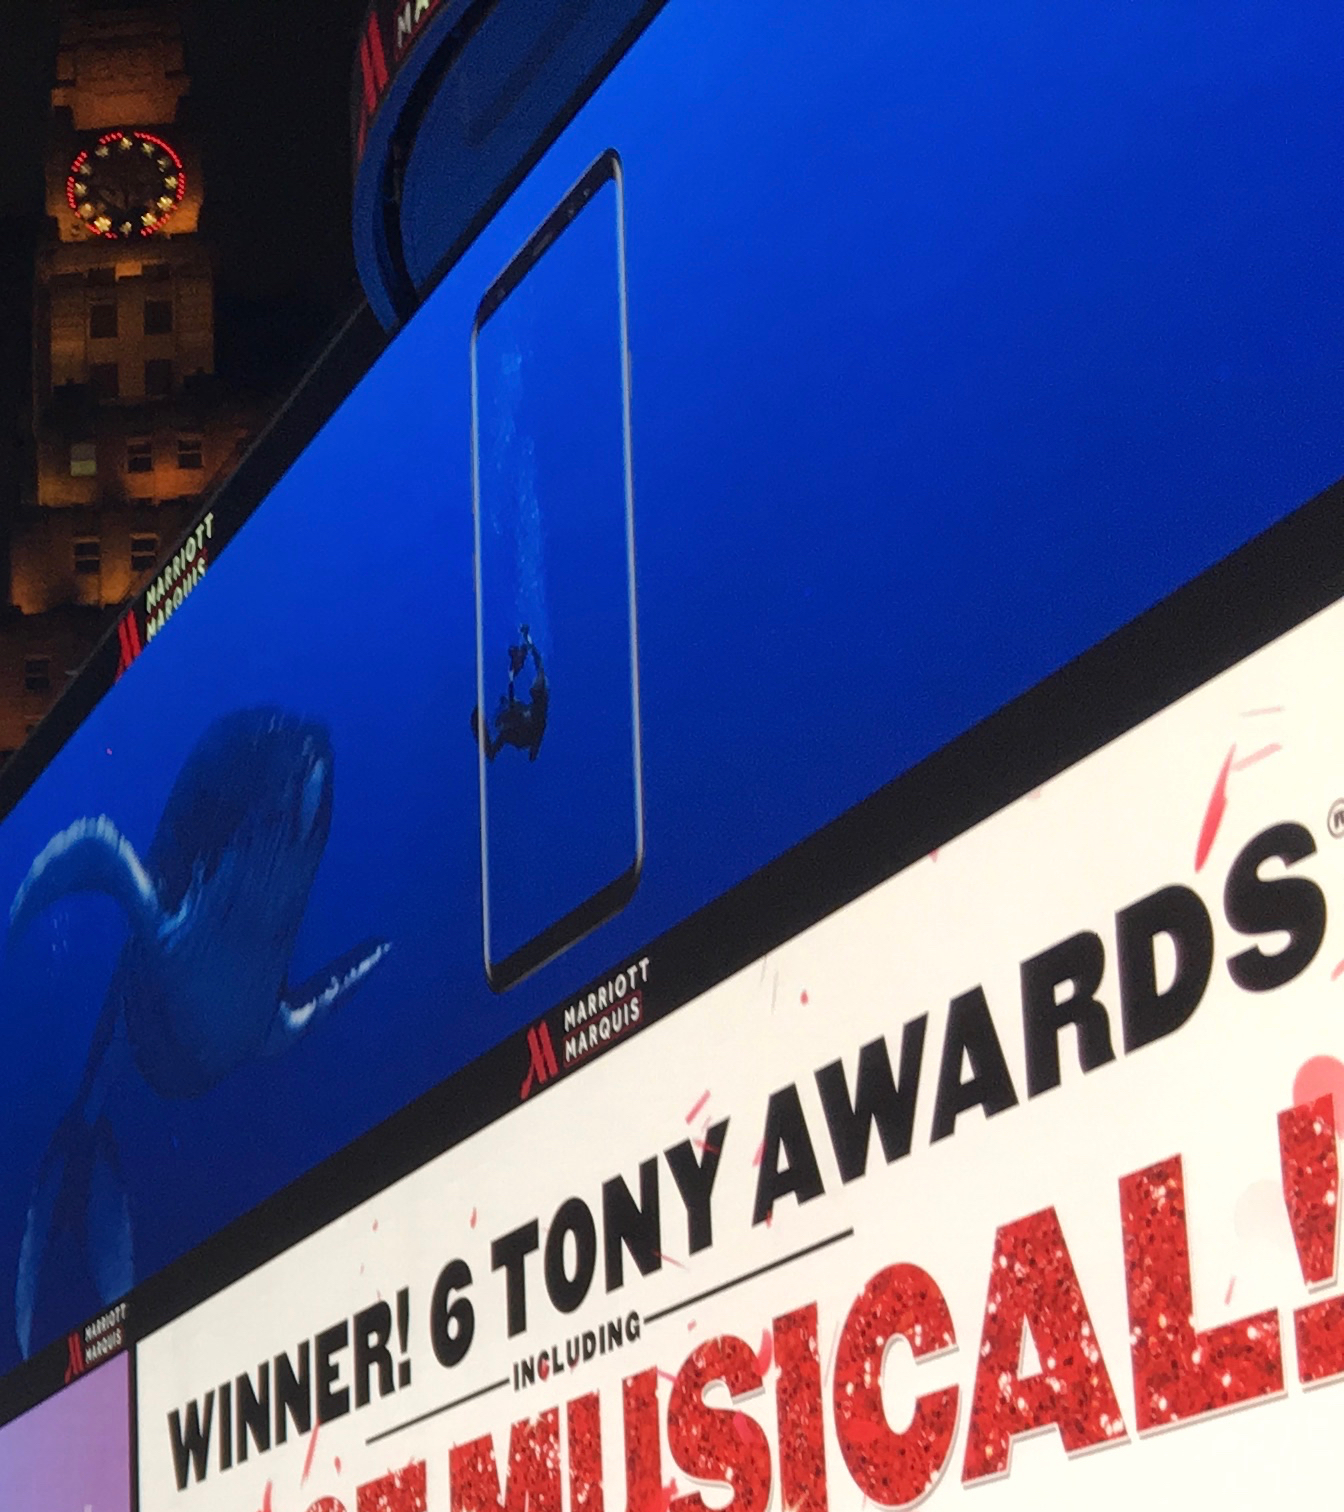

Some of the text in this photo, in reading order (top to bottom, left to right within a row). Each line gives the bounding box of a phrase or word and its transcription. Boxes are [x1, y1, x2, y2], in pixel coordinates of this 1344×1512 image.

[145, 511, 214, 613] MARRIOTT
[145, 556, 208, 643] MARQUIS
[563, 957, 652, 1032] MARRIOTT
[563, 997, 642, 1063] MARQUIS
[166, 820, 1328, 1492] WINNER! 6 TONY AWARDS
[84, 1302, 127, 1343] MARRIOTT
[84, 1327, 124, 1365] MARQUIS
[512, 1310, 643, 1392] INCLUDING
